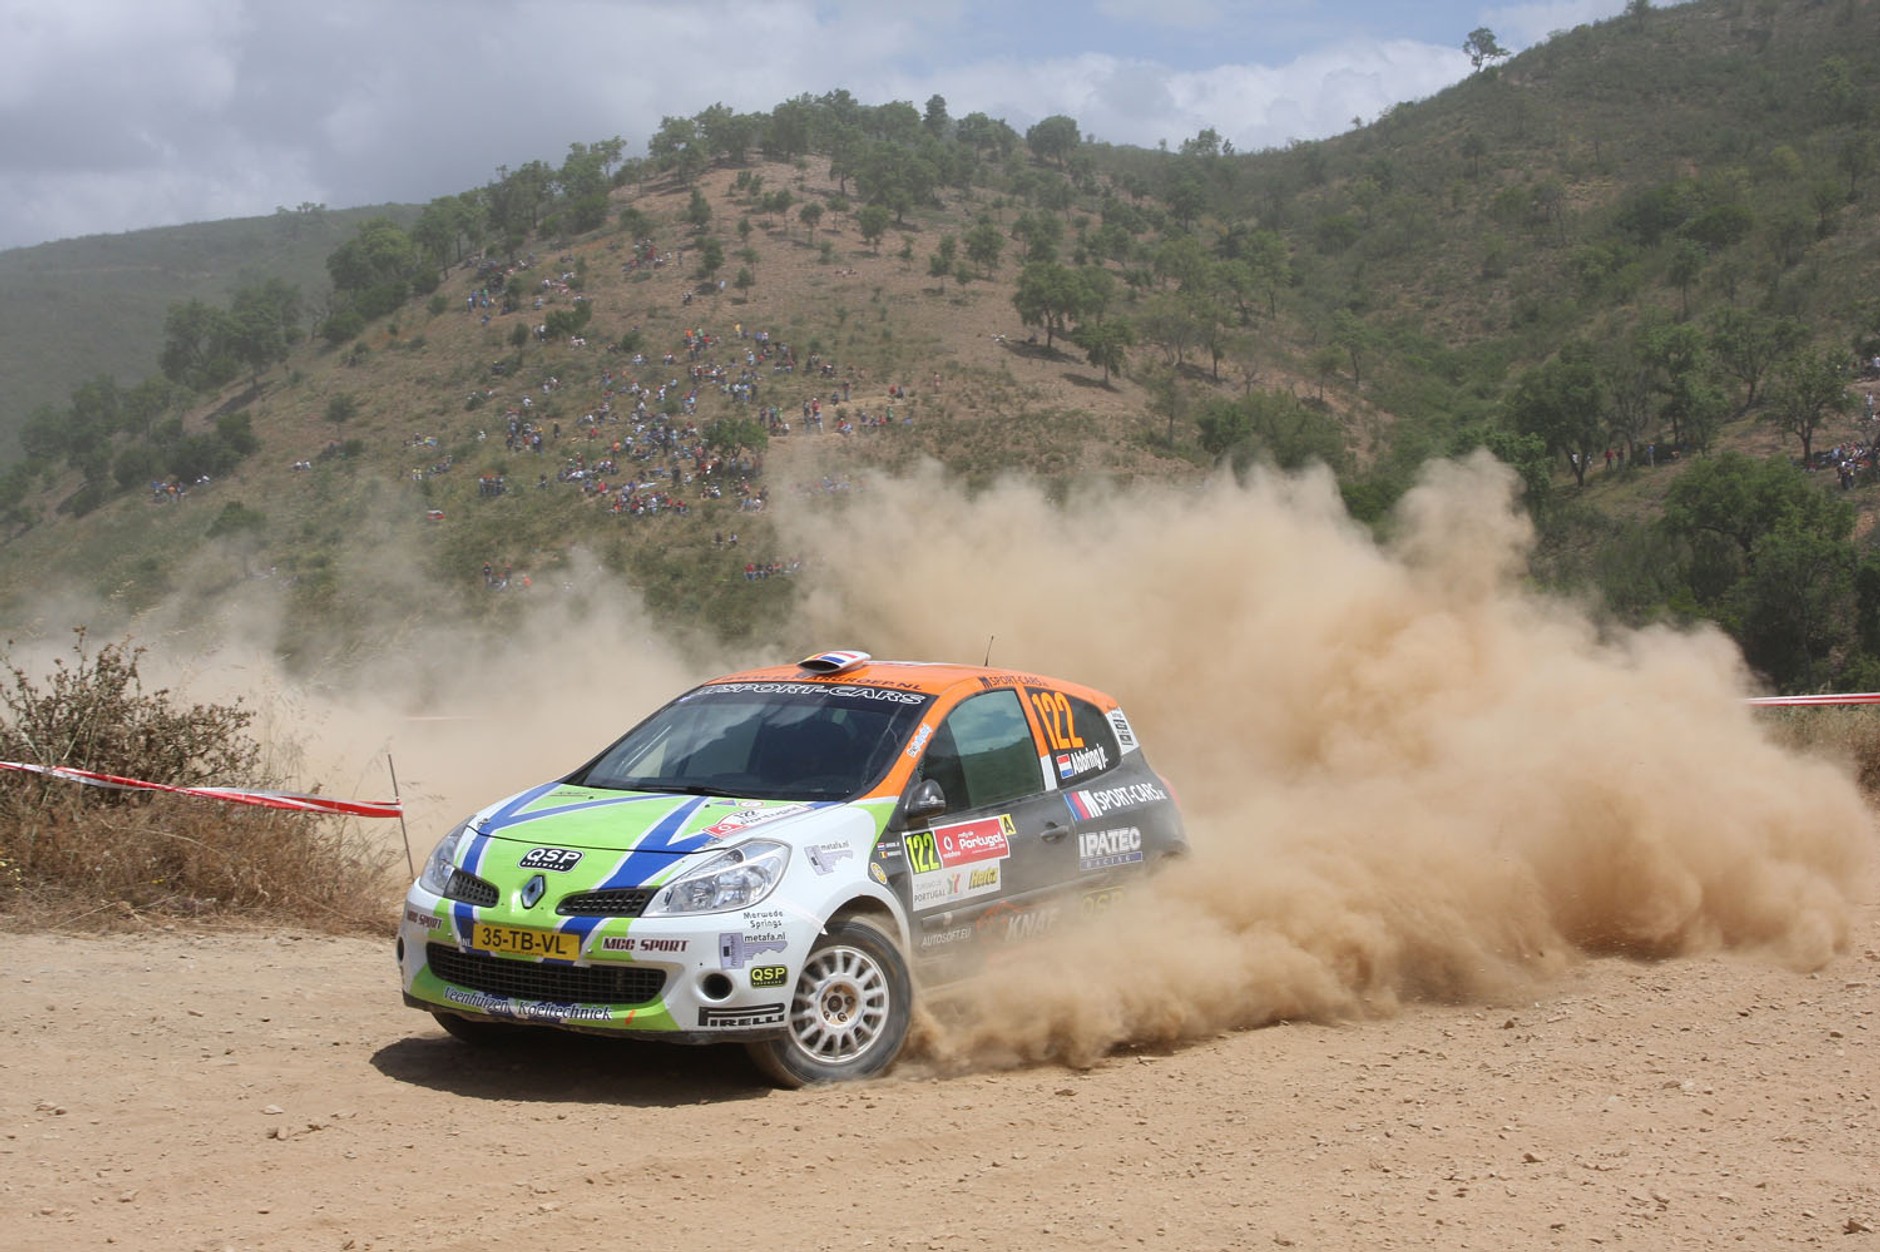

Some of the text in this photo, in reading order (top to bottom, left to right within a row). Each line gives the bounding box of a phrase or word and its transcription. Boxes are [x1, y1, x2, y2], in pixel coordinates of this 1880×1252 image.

[1032, 691, 1085, 750] 122
[1070, 747, 1103, 775] Abbring
[1003, 817, 1015, 833] A
[820, 841, 850, 851] metafa.nl
[959, 832, 1005, 850] Portugal
[1078, 826, 1141, 858] IPATEC
[526, 848, 580, 863] QSP
[906, 832, 940, 874] 122
[968, 867, 999, 890] Hertz
[913, 888, 946, 902] PORTUGAL
[418, 913, 443, 930] SPORT
[743, 910, 784, 920] Merwede
[750, 919, 782, 930] Springs
[462, 938, 473, 948] NL
[481, 927, 567, 955] 35-TB-VL
[744, 931, 786, 942] metafa.nl
[921, 927, 972, 948] AUTOSOFT.EU
[640, 939, 690, 953] SPORT
[751, 966, 786, 981] QSP
[444, 985, 614, 1022] Veenhuizen Koeltechniek
[698, 1002, 786, 1028] PIRELLI
